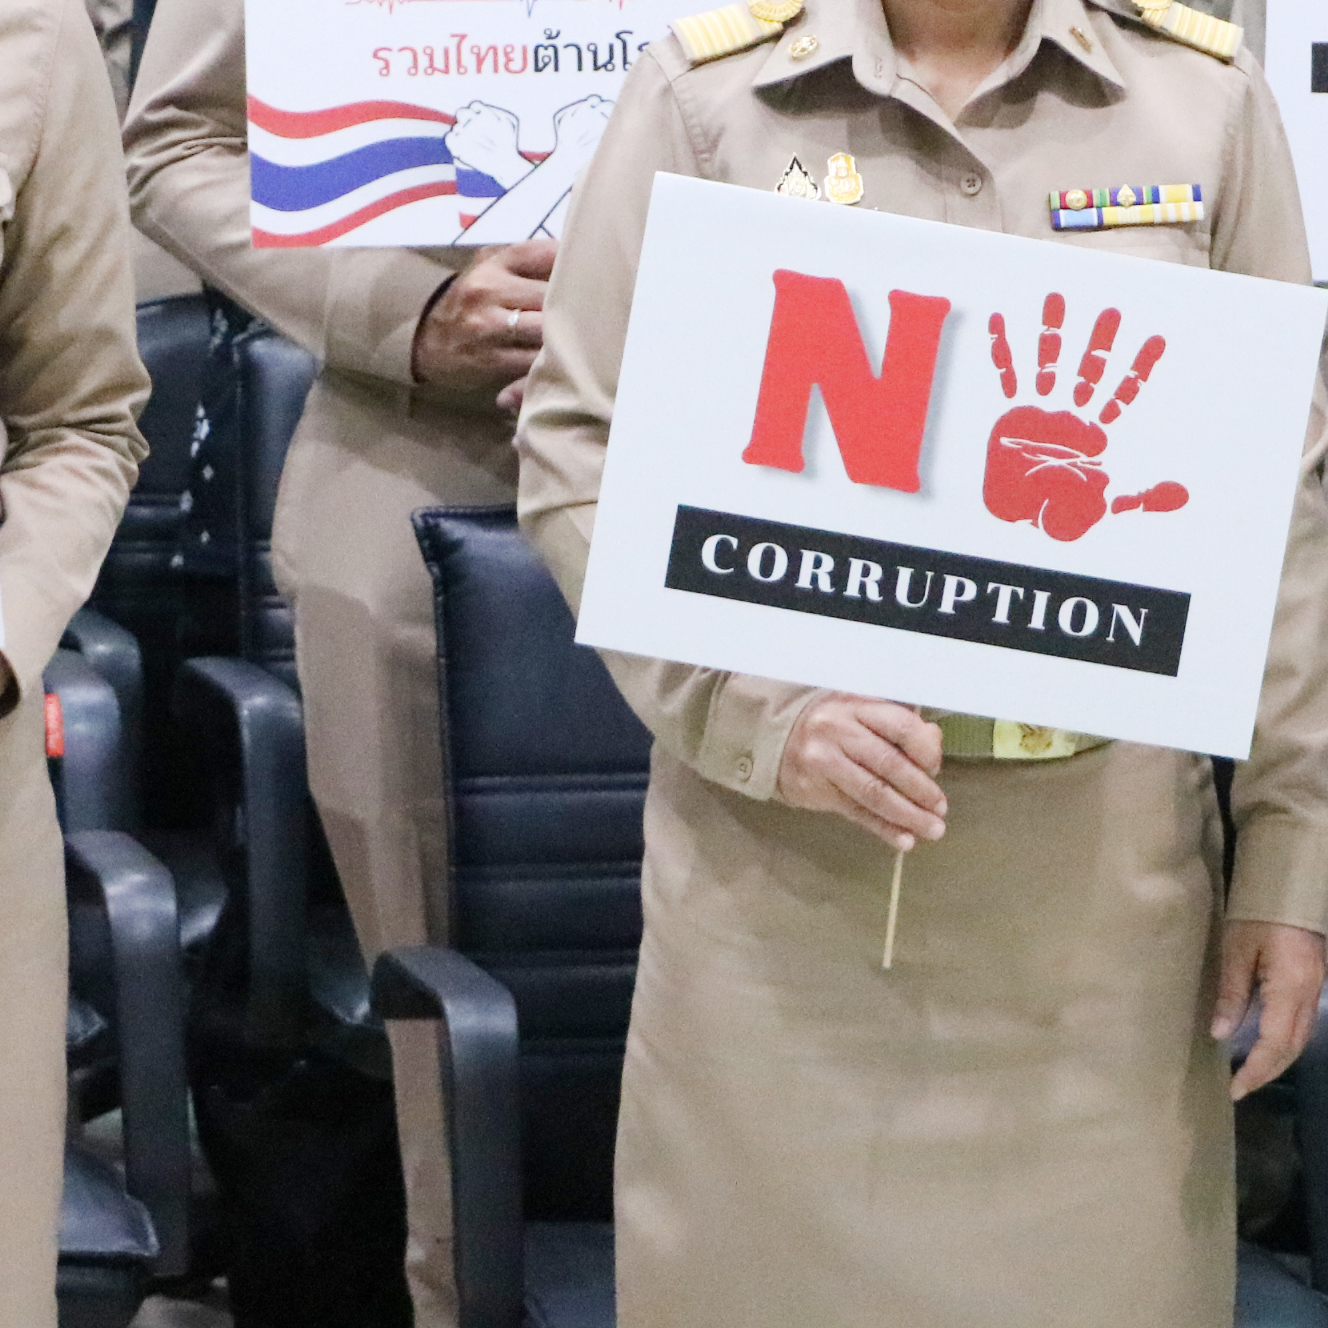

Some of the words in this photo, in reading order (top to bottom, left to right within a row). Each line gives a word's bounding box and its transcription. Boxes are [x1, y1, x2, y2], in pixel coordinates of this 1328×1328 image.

[372, 28, 650, 77] รวมไทยต้านโ
[742, 269, 952, 492] N
[701, 533, 1150, 647] CORRUPTION
